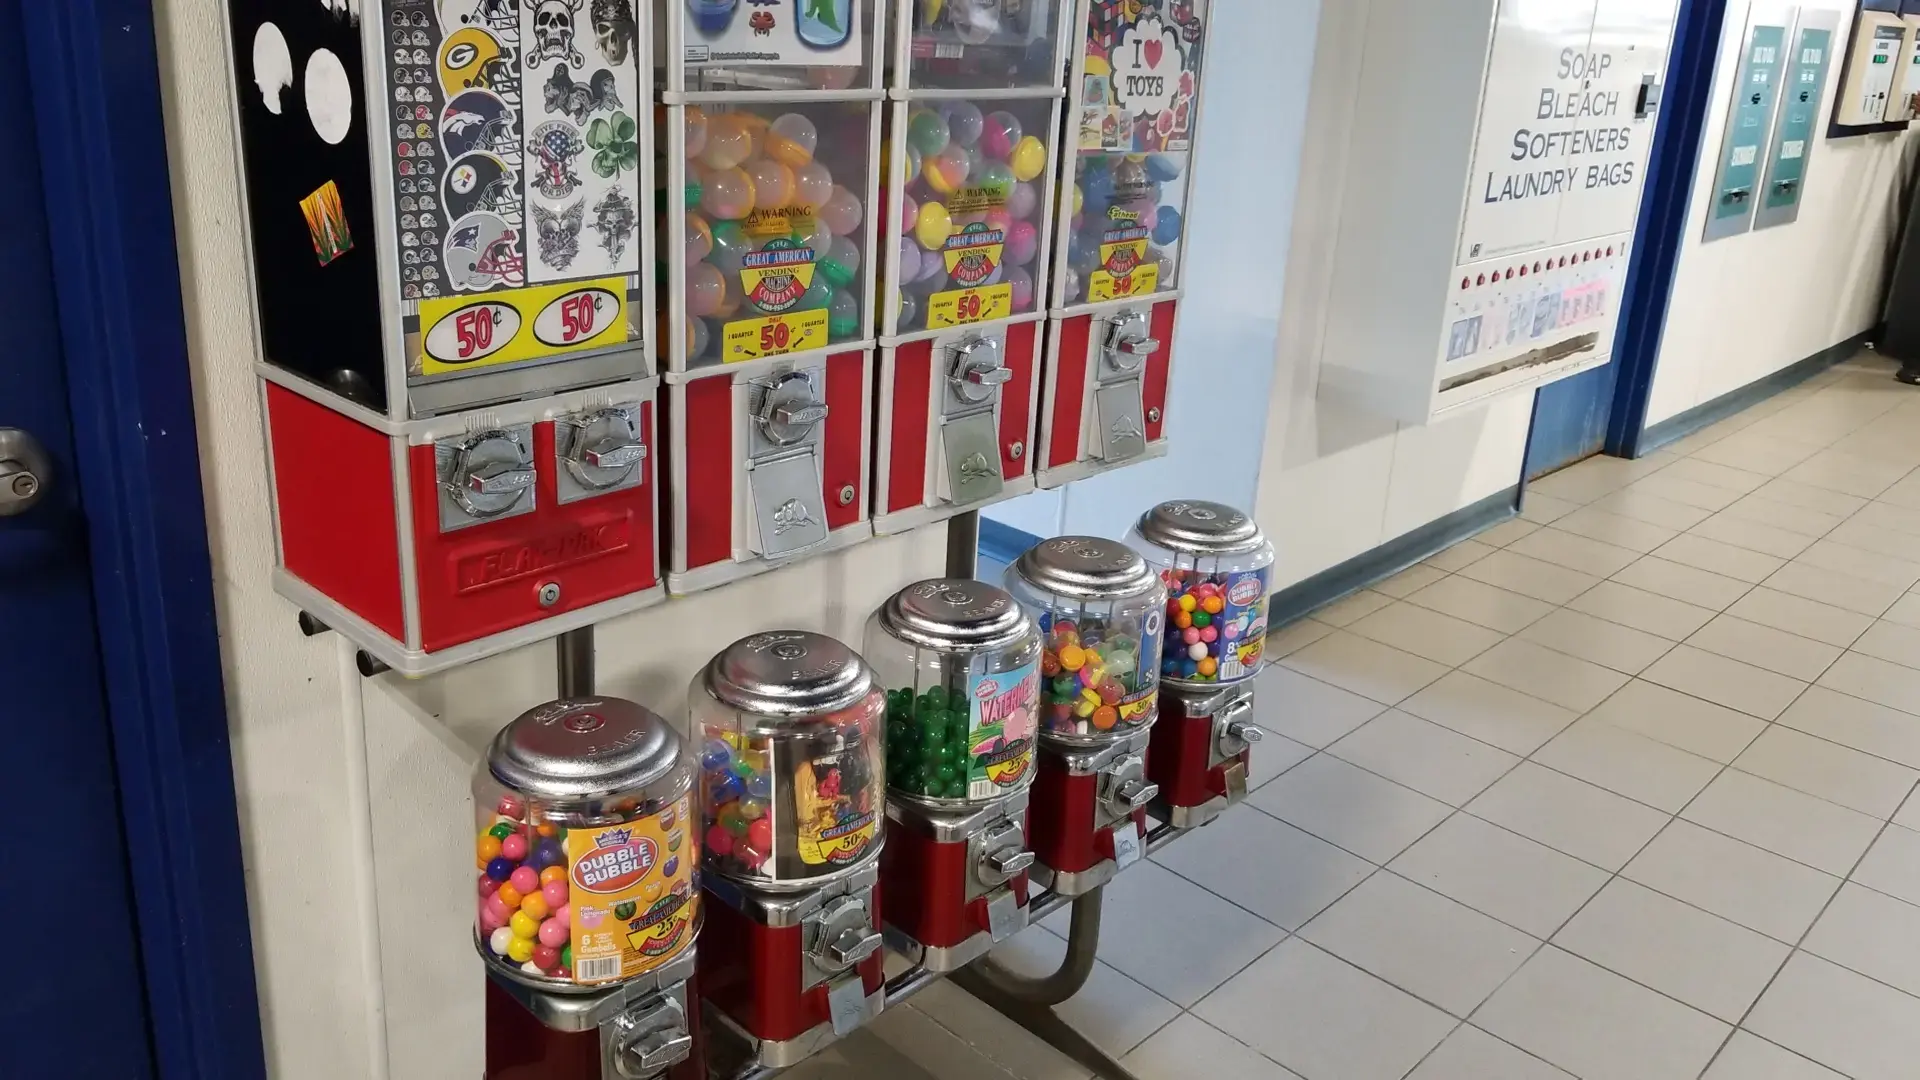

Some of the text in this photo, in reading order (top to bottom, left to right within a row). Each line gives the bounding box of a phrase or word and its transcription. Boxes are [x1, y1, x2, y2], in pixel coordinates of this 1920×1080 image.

[1132, 39, 1143, 68] I
[1557, 47, 1612, 80] SOAP
[1126, 75, 1164, 97] TOYS
[1536, 88, 1620, 120] BLEACH
[535, 124, 576, 138] LIVE FREE
[1510, 127, 1632, 161] SOFTENERS
[1484, 161, 1635, 204] LAUNDRY BAGS
[542, 185, 571, 197] OR DIE
[966, 187, 1001, 197] WARNING
[761, 205, 811, 220] WARNING
[771, 241, 788, 249] THE
[949, 236, 969, 247] GREAT
[746, 249, 811, 267] GREAT AMERICAN
[957, 248, 991, 257] VENDING
[758, 267, 800, 277] VENDING
[957, 265, 988, 281] COMPANY
[759, 286, 796, 304] COMPANY
[804, 318, 825, 327] QUARTER
[731, 330, 754, 340] QUARTER
[1227, 642, 1235, 654] 8
[598, 832, 628, 844] AMERICA'S
[823, 825, 845, 837] GREAT
[579, 842, 649, 874] DUBBLE
[583, 854, 652, 886] BUBBLE
[632, 915, 658, 931] GREAT
[581, 934, 591, 946] 6
[581, 942, 617, 954] Gumballs
